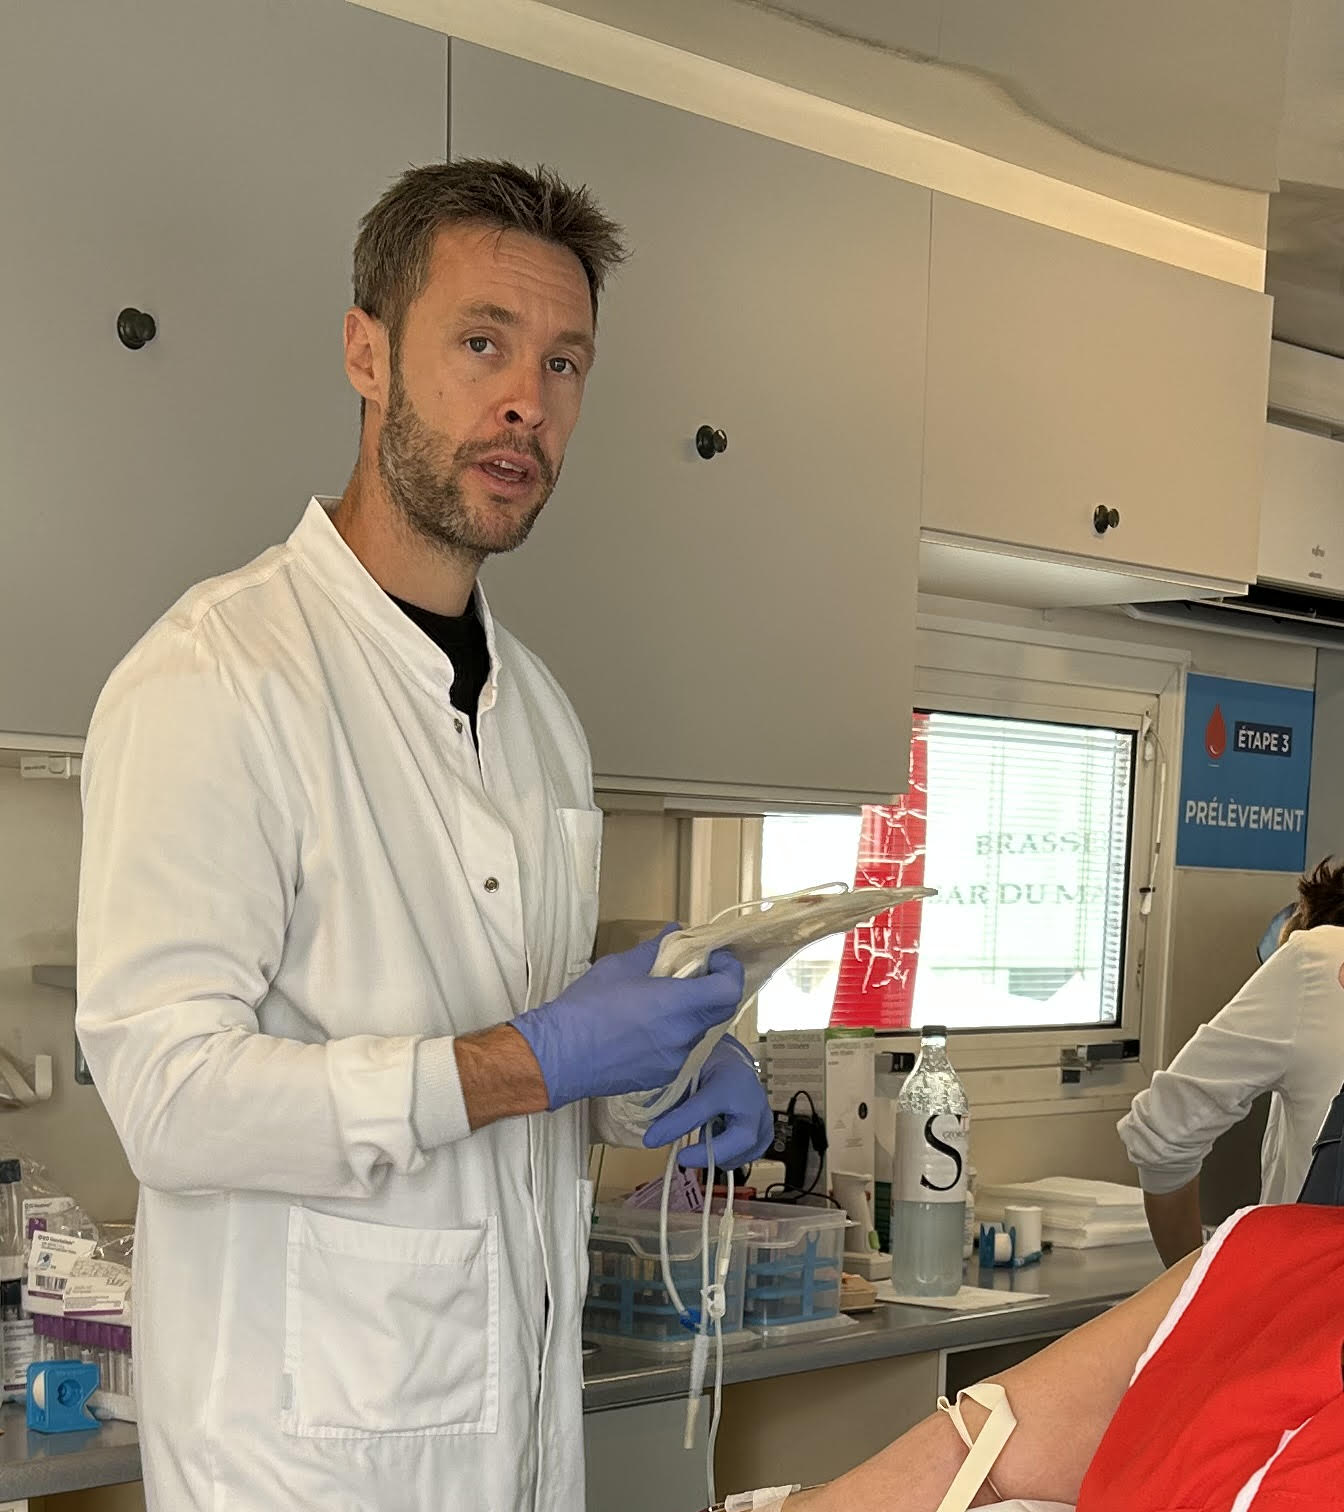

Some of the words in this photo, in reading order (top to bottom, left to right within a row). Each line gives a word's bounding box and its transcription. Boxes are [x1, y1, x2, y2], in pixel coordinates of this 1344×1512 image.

[1238, 726, 1278, 752] ÉTAPE
[1281, 735, 1290, 753] 3
[1185, 796, 1305, 833] PRÉLÈVEMENT
